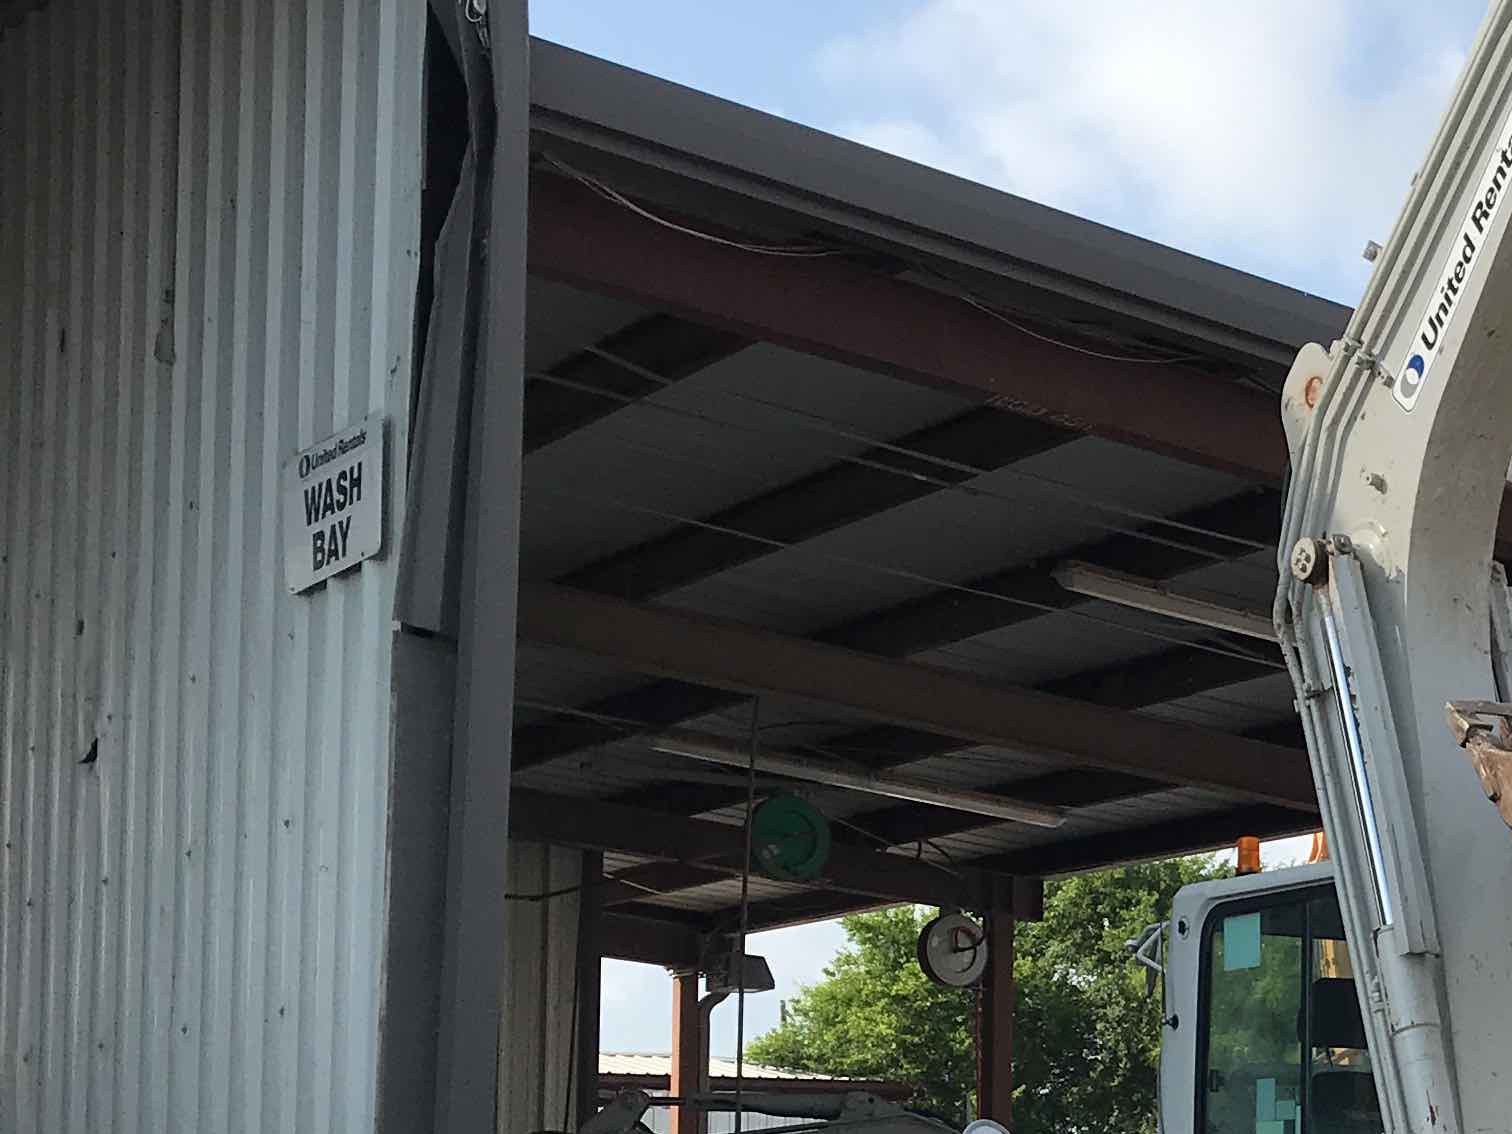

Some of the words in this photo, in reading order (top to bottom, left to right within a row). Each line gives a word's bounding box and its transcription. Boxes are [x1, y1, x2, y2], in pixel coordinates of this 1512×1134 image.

[1421, 232, 1476, 351] United
[311, 442, 338, 470] United
[304, 461, 363, 527] WASH
[312, 515, 352, 572] BAY
